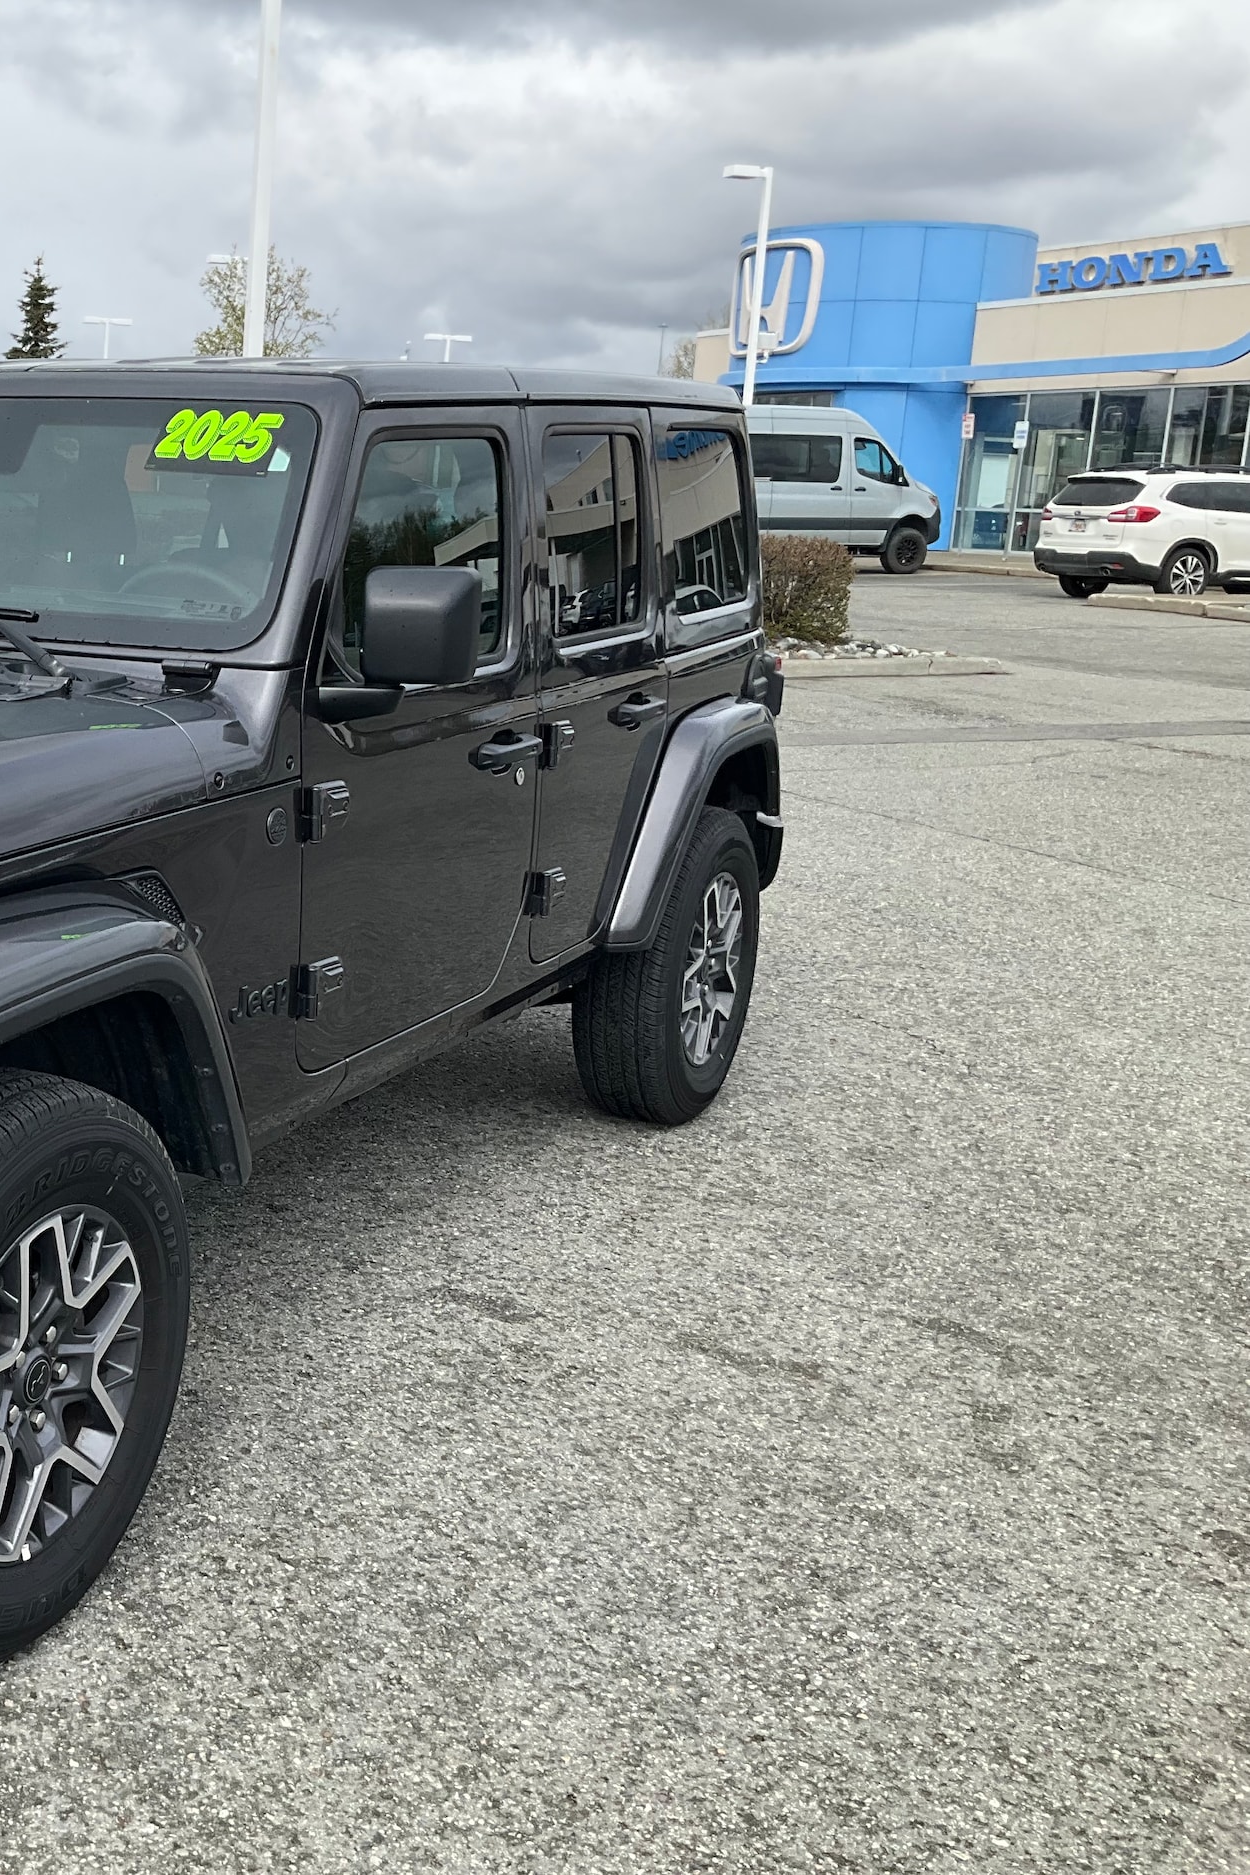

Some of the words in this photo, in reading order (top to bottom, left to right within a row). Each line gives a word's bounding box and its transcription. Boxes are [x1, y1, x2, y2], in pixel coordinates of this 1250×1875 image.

[1034, 242, 1230, 293] HONDA
[154, 408, 285, 464] 2025
[228, 979, 288, 1025] Jeep
[4, 1146, 183, 1277] BRIDGESTONE
